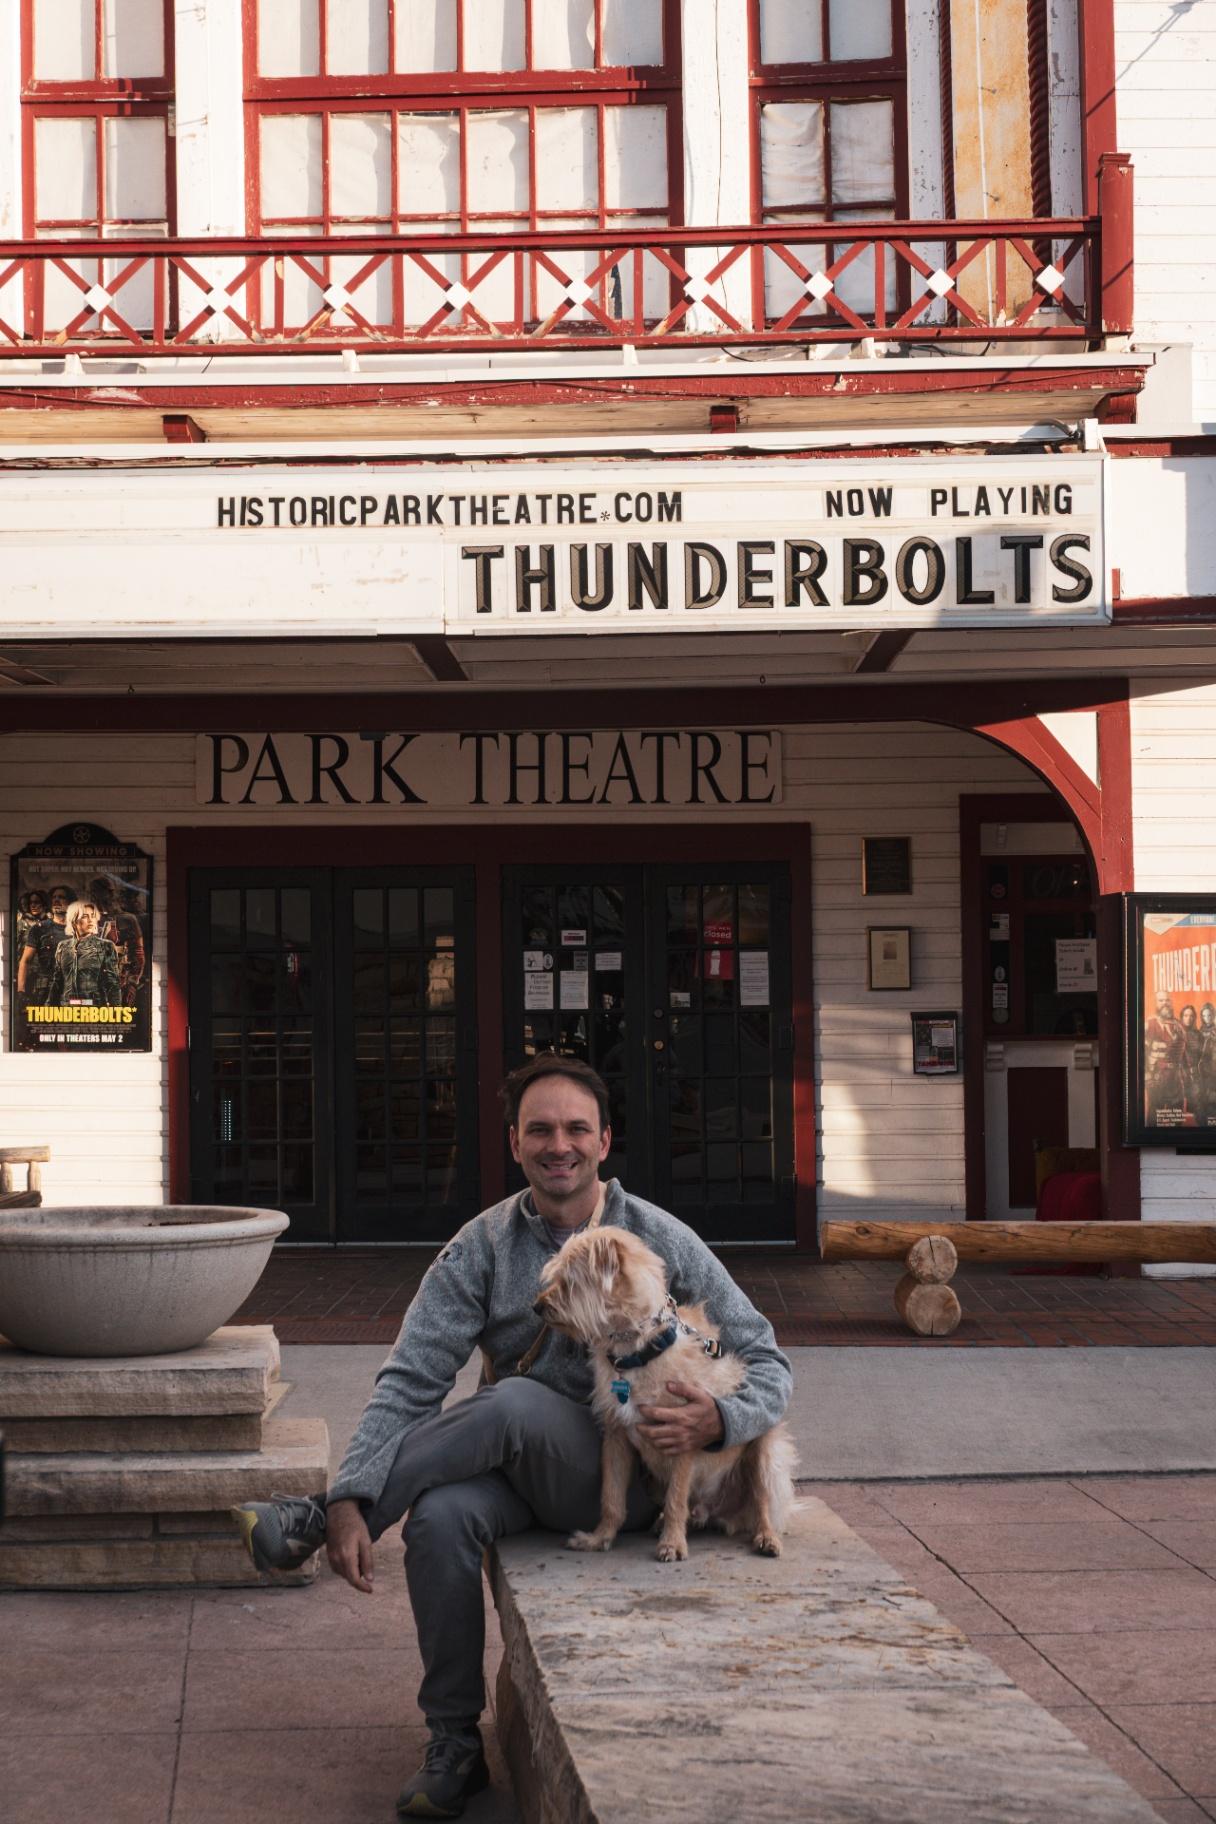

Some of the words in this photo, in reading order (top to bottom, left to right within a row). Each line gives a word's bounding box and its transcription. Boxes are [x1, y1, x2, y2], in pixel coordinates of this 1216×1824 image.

[826, 488, 893, 518] NOW
[931, 484, 1073, 517] PLAYING
[462, 533, 1094, 613] THUNDERBOLTS
[205, 732, 428, 805] PARK
[459, 731, 776, 805] THEATRE
[35, 847, 63, 856] NOW
[70, 847, 128, 856] SHOWING
[39, 1034, 56, 1043] ONLY
[57, 1034, 65, 1043] IN
[66, 1034, 100, 1043] THEATERS
[101, 1034, 116, 1043] MAY
[118, 1034, 124, 1043] 2
